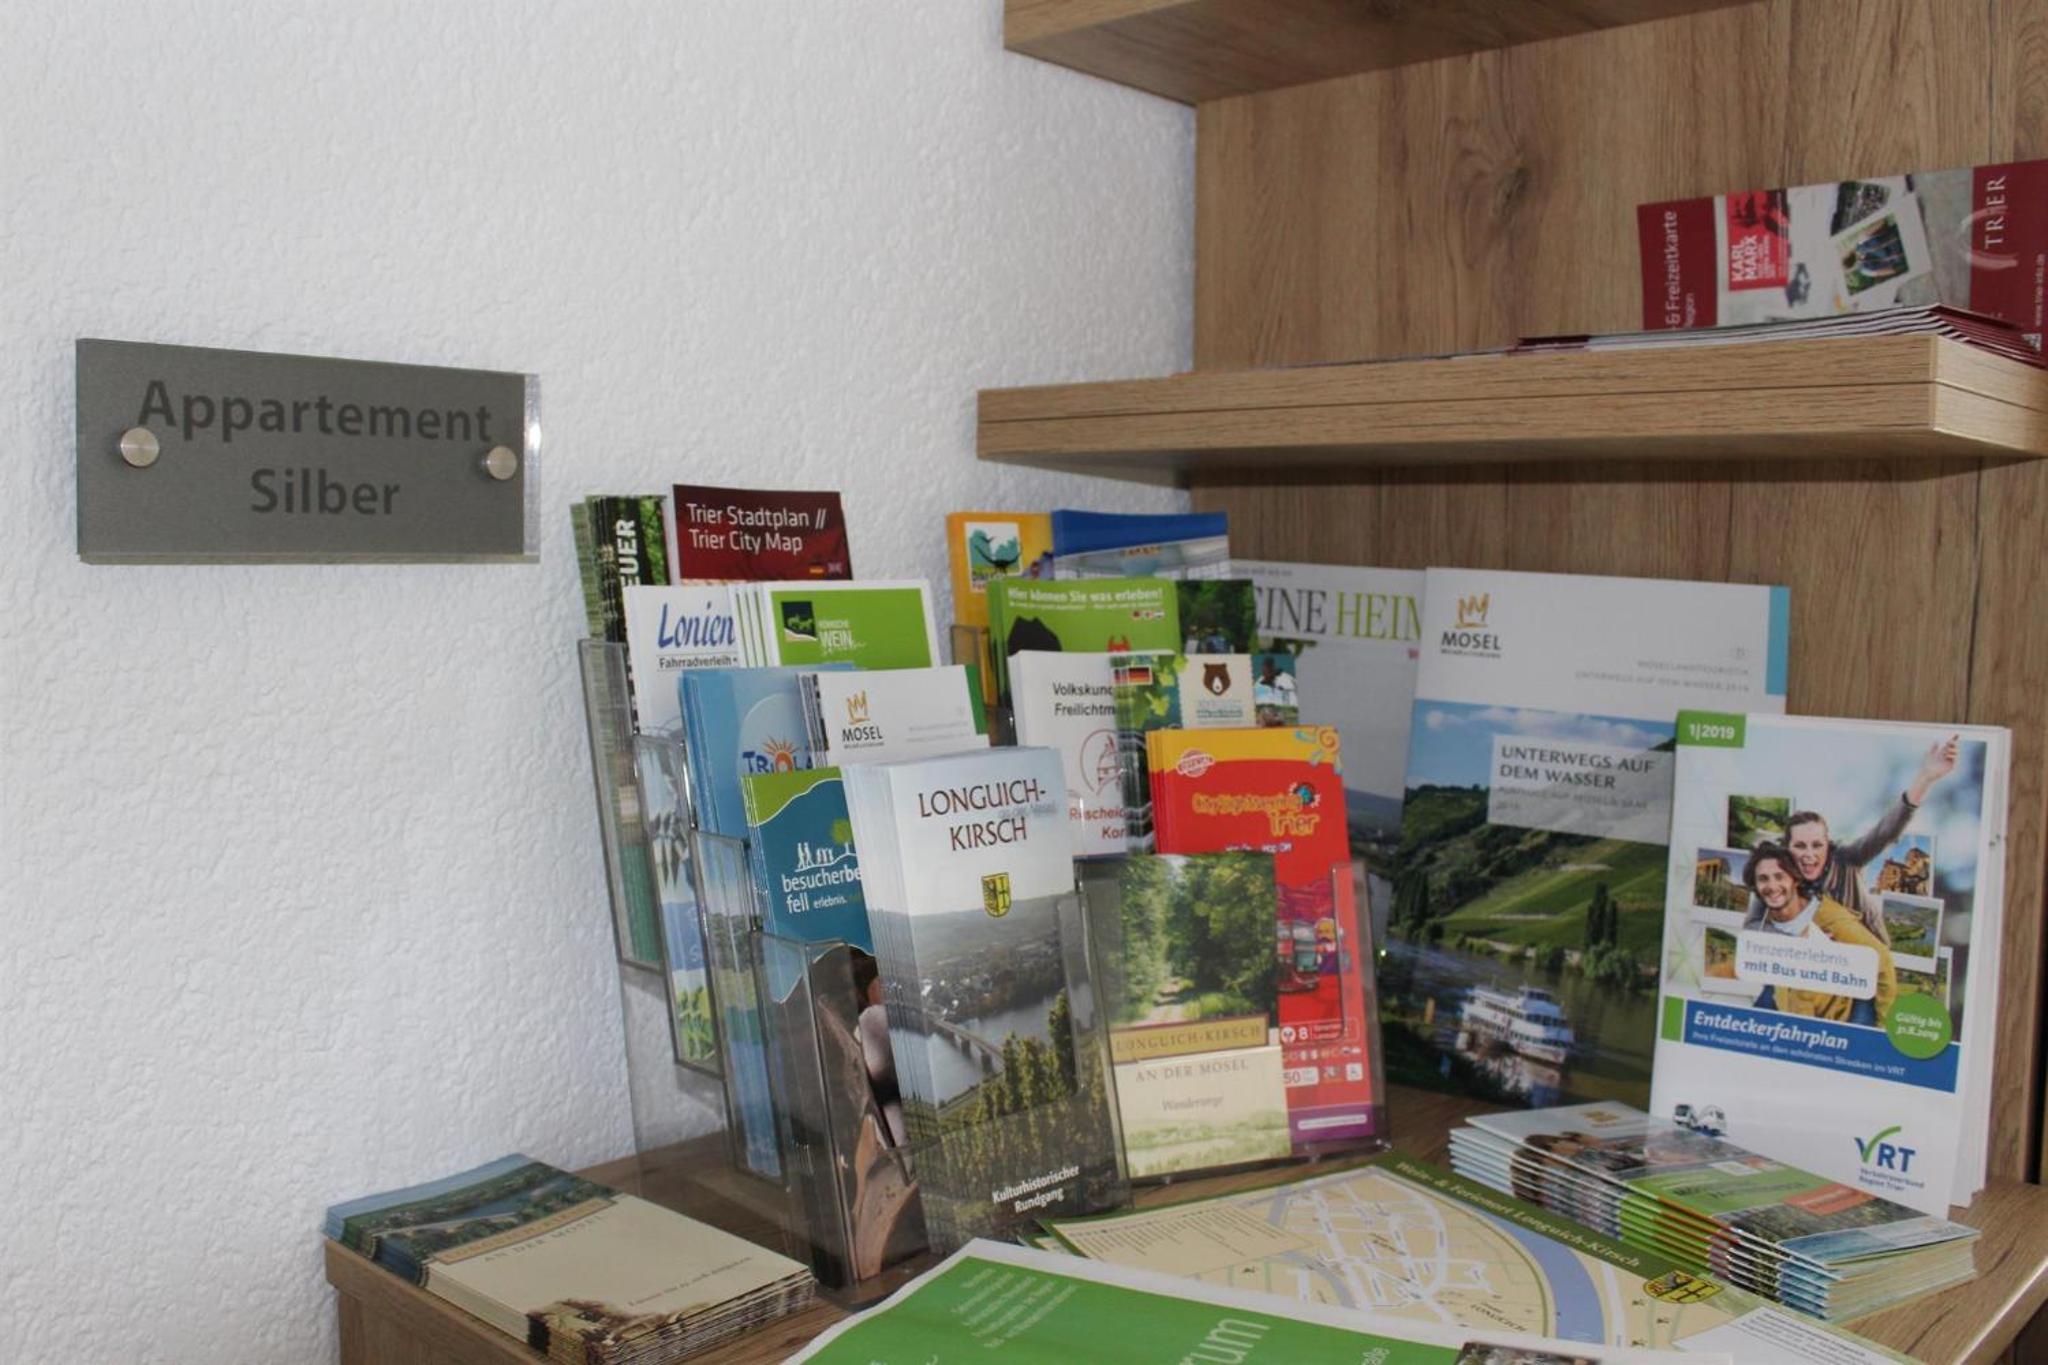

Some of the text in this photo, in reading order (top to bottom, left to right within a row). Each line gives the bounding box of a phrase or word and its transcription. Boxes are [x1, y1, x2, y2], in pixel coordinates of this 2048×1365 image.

[1663, 210, 1681, 310] Freizeitkarte
[1744, 235, 1757, 280] MARX
[138, 379, 492, 443] Appartement
[250, 468, 400, 516] Silber
[686, 503, 723, 525] Trier
[727, 506, 810, 532] Stadtplan
[689, 529, 804, 556] Trier City Map
[658, 601, 736, 649] Lonien
[1441, 631, 1502, 651] MOSEL
[658, 656, 732, 669] Fahrradverleih
[842, 727, 883, 742] MOSEL
[1501, 745, 1658, 774] UNTERWEGS AUF
[1500, 764, 1617, 790] DEM WASSER
[918, 778, 1047, 818] LONGUICH-
[950, 815, 1028, 851] KIRSCH
[786, 892, 810, 914] fell
[1745, 940, 1850, 967] Freizeiterlebnis
[1743, 959, 1869, 989] mit Bus und Bahn
[1693, 1010, 1849, 1050] Entdeckerfahrplan
[1134, 1058, 1249, 1083] AN DER MOSEL
[1854, 1126, 1916, 1173] VRT
[991, 1163, 1081, 1206] Kulturhistorischer
[1014, 1186, 1066, 1214] Rundgang
[1513, 1208, 1641, 1268] Longuich-Kirsch
